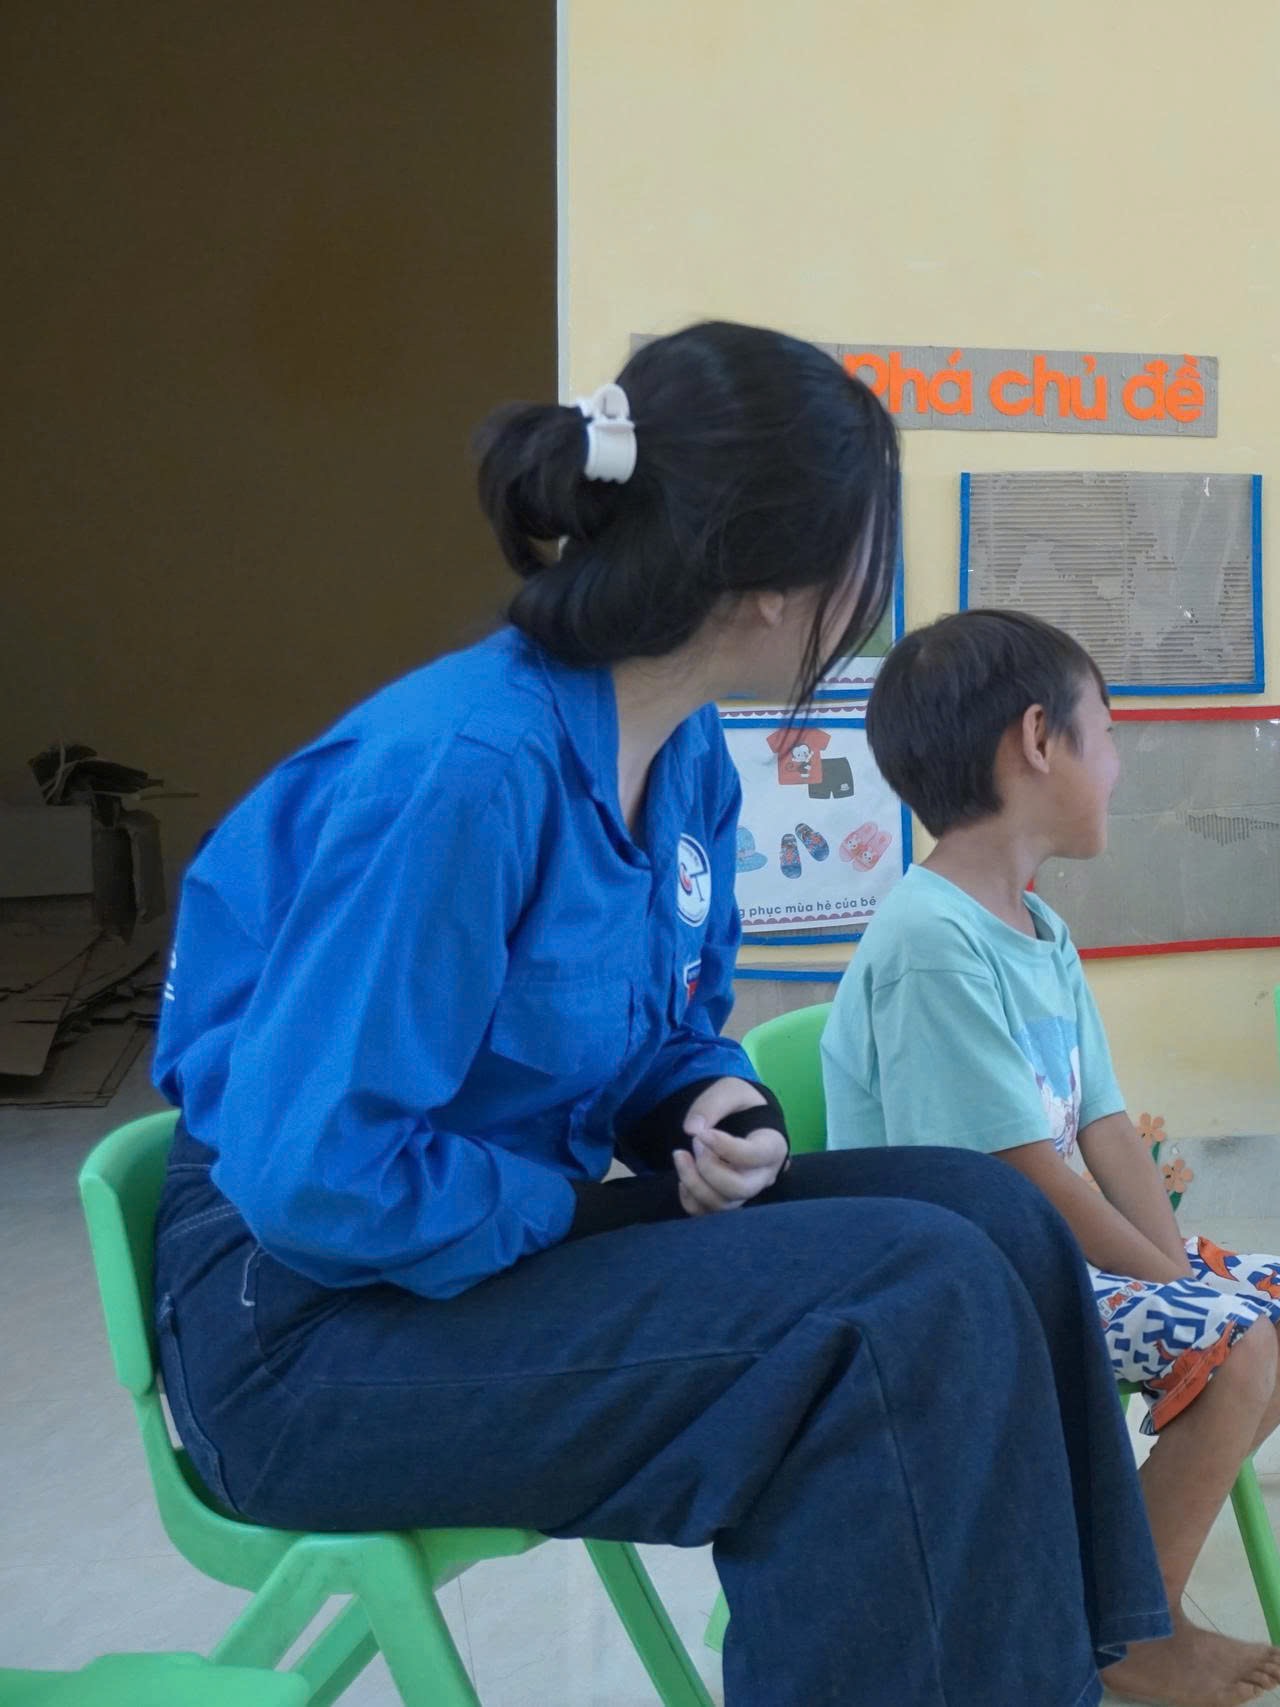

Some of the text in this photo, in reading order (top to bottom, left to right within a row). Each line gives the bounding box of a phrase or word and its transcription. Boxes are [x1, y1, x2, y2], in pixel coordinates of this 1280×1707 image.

[988, 354, 1108, 421] chủ
[1121, 353, 1205, 424] đề
[749, 905, 782, 918] phục
[785, 902, 813, 914] mùa
[834, 897, 857, 909] của
